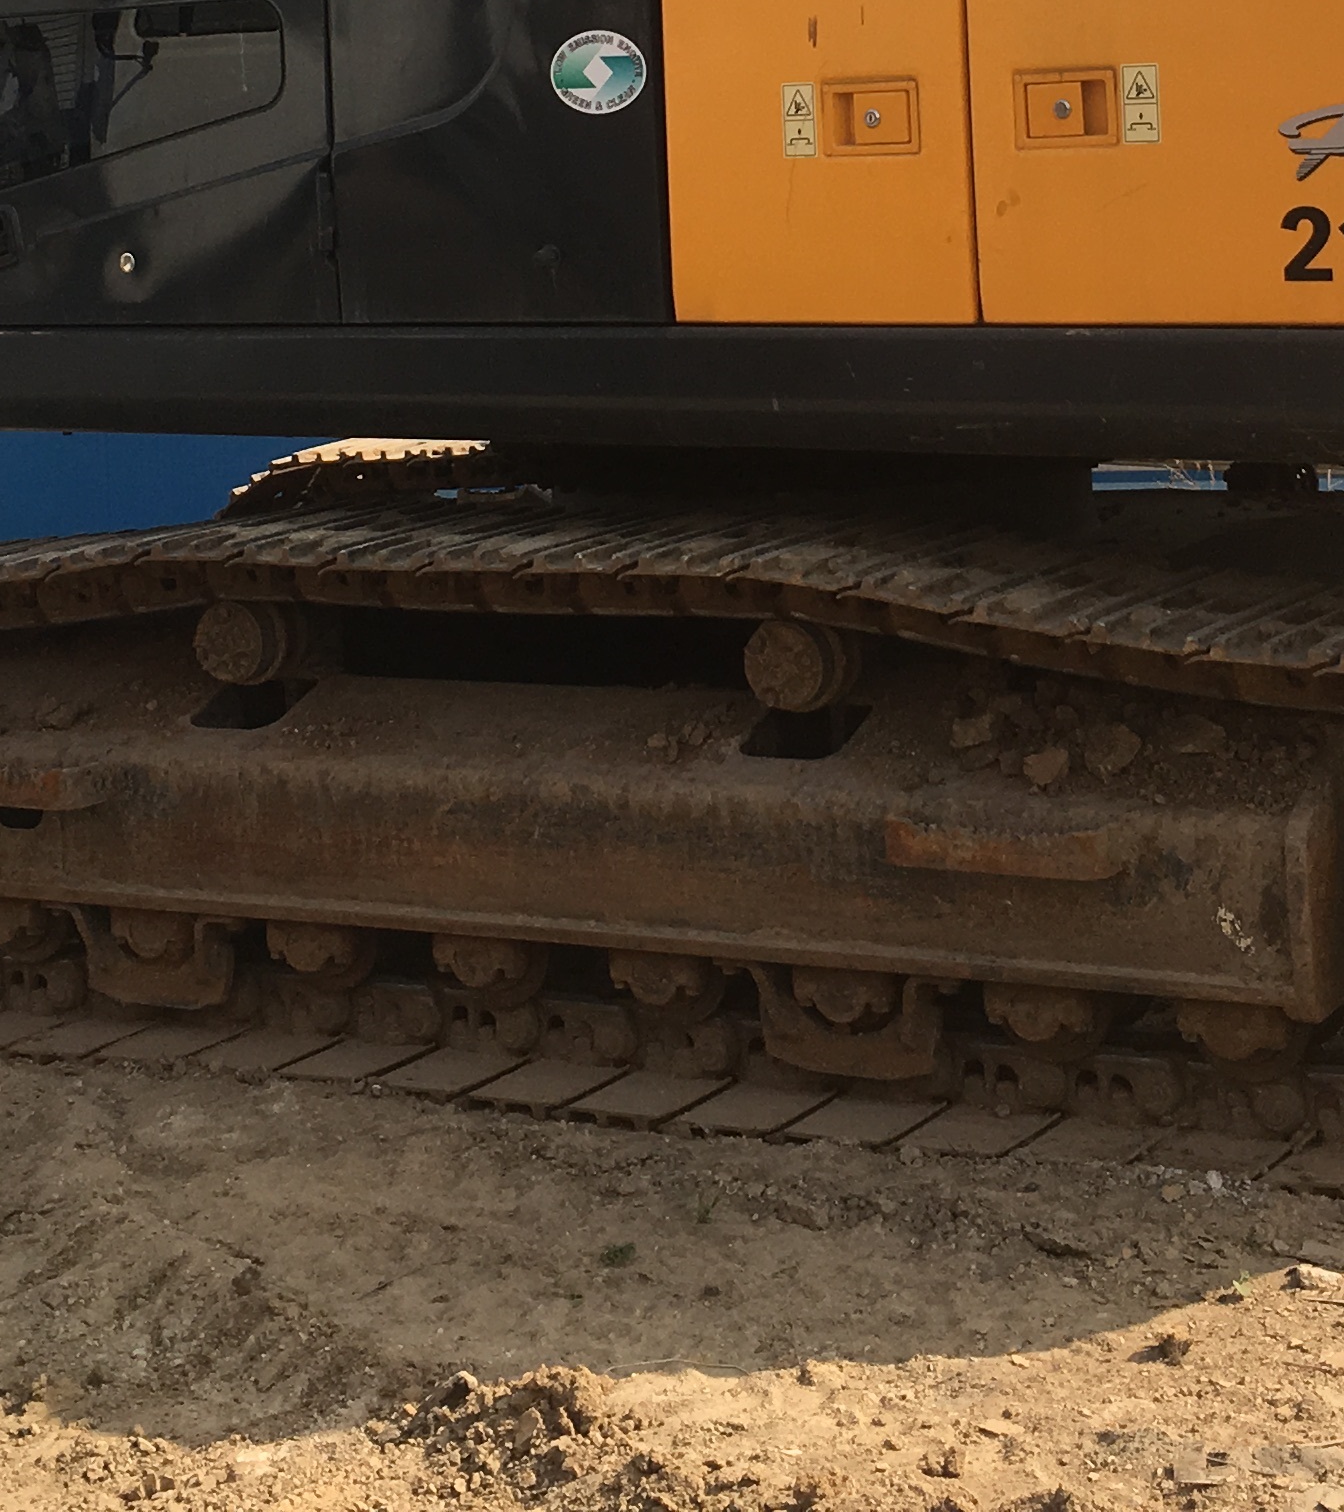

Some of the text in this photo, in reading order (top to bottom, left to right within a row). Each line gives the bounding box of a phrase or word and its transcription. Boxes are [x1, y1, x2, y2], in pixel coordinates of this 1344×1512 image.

[555, 50, 568, 76] LOW
[567, 34, 614, 52] EMISSION
[560, 87, 592, 110] GREEN
[606, 84, 636, 110] CLEAN
